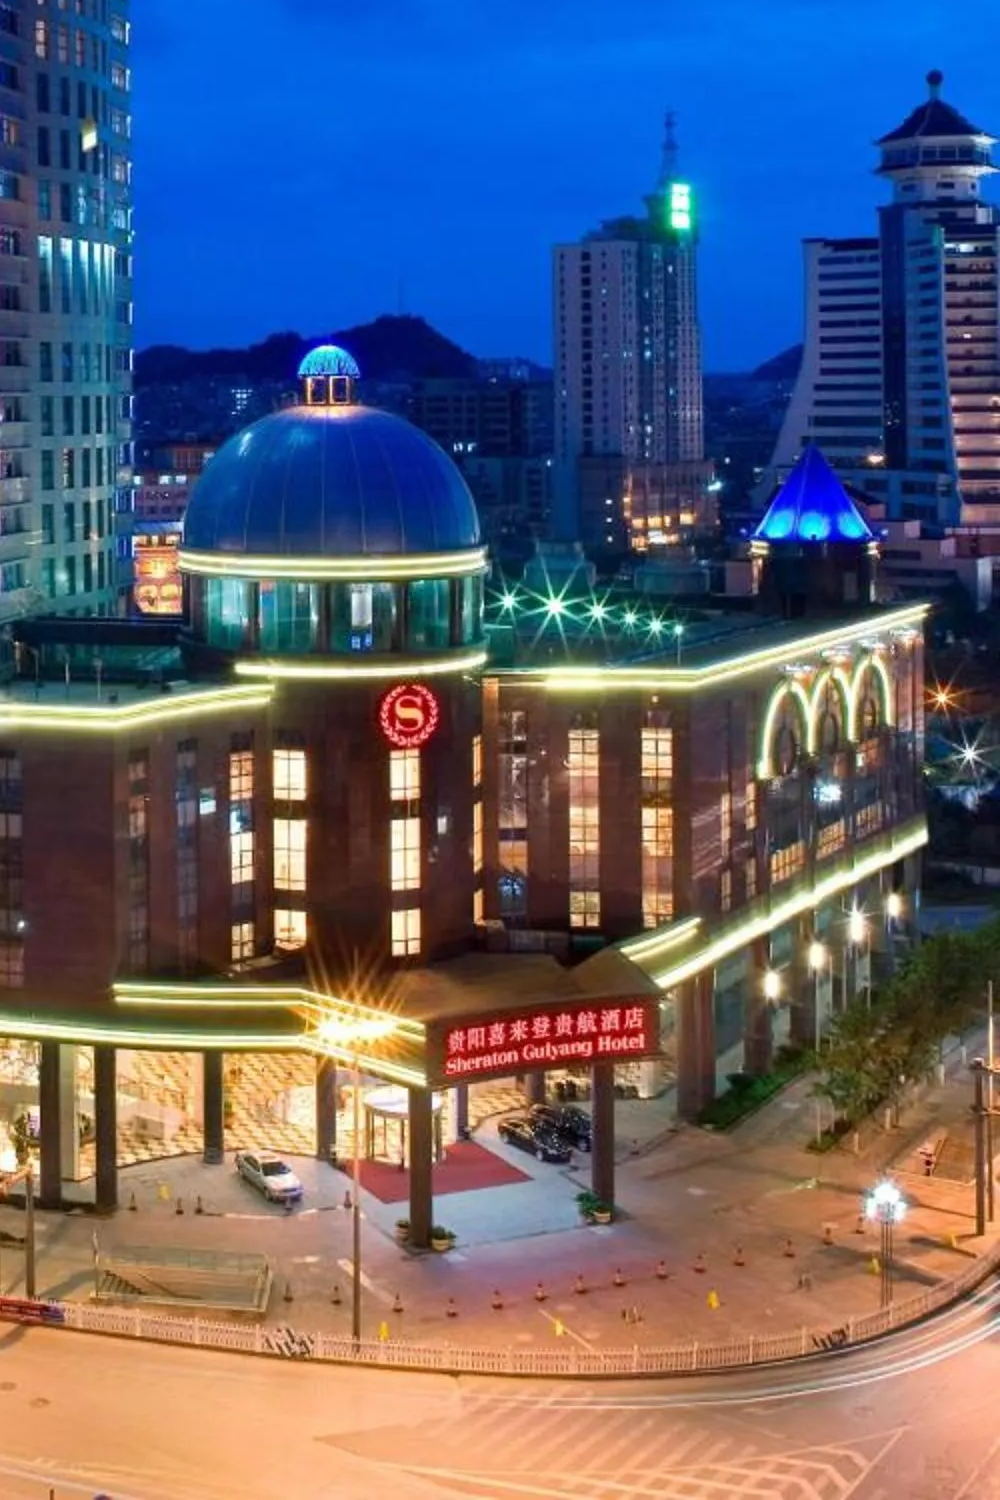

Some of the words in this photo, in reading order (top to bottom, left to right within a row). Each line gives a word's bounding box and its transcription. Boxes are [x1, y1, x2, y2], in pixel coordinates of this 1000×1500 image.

[395, 695, 425, 732] S
[448, 1007, 645, 1054] 贵阳喜来登贵航酒店
[445, 1049, 519, 1075] Sheraton
[523, 1040, 593, 1061] Guiyang
[597, 1033, 645, 1052] Hotel
